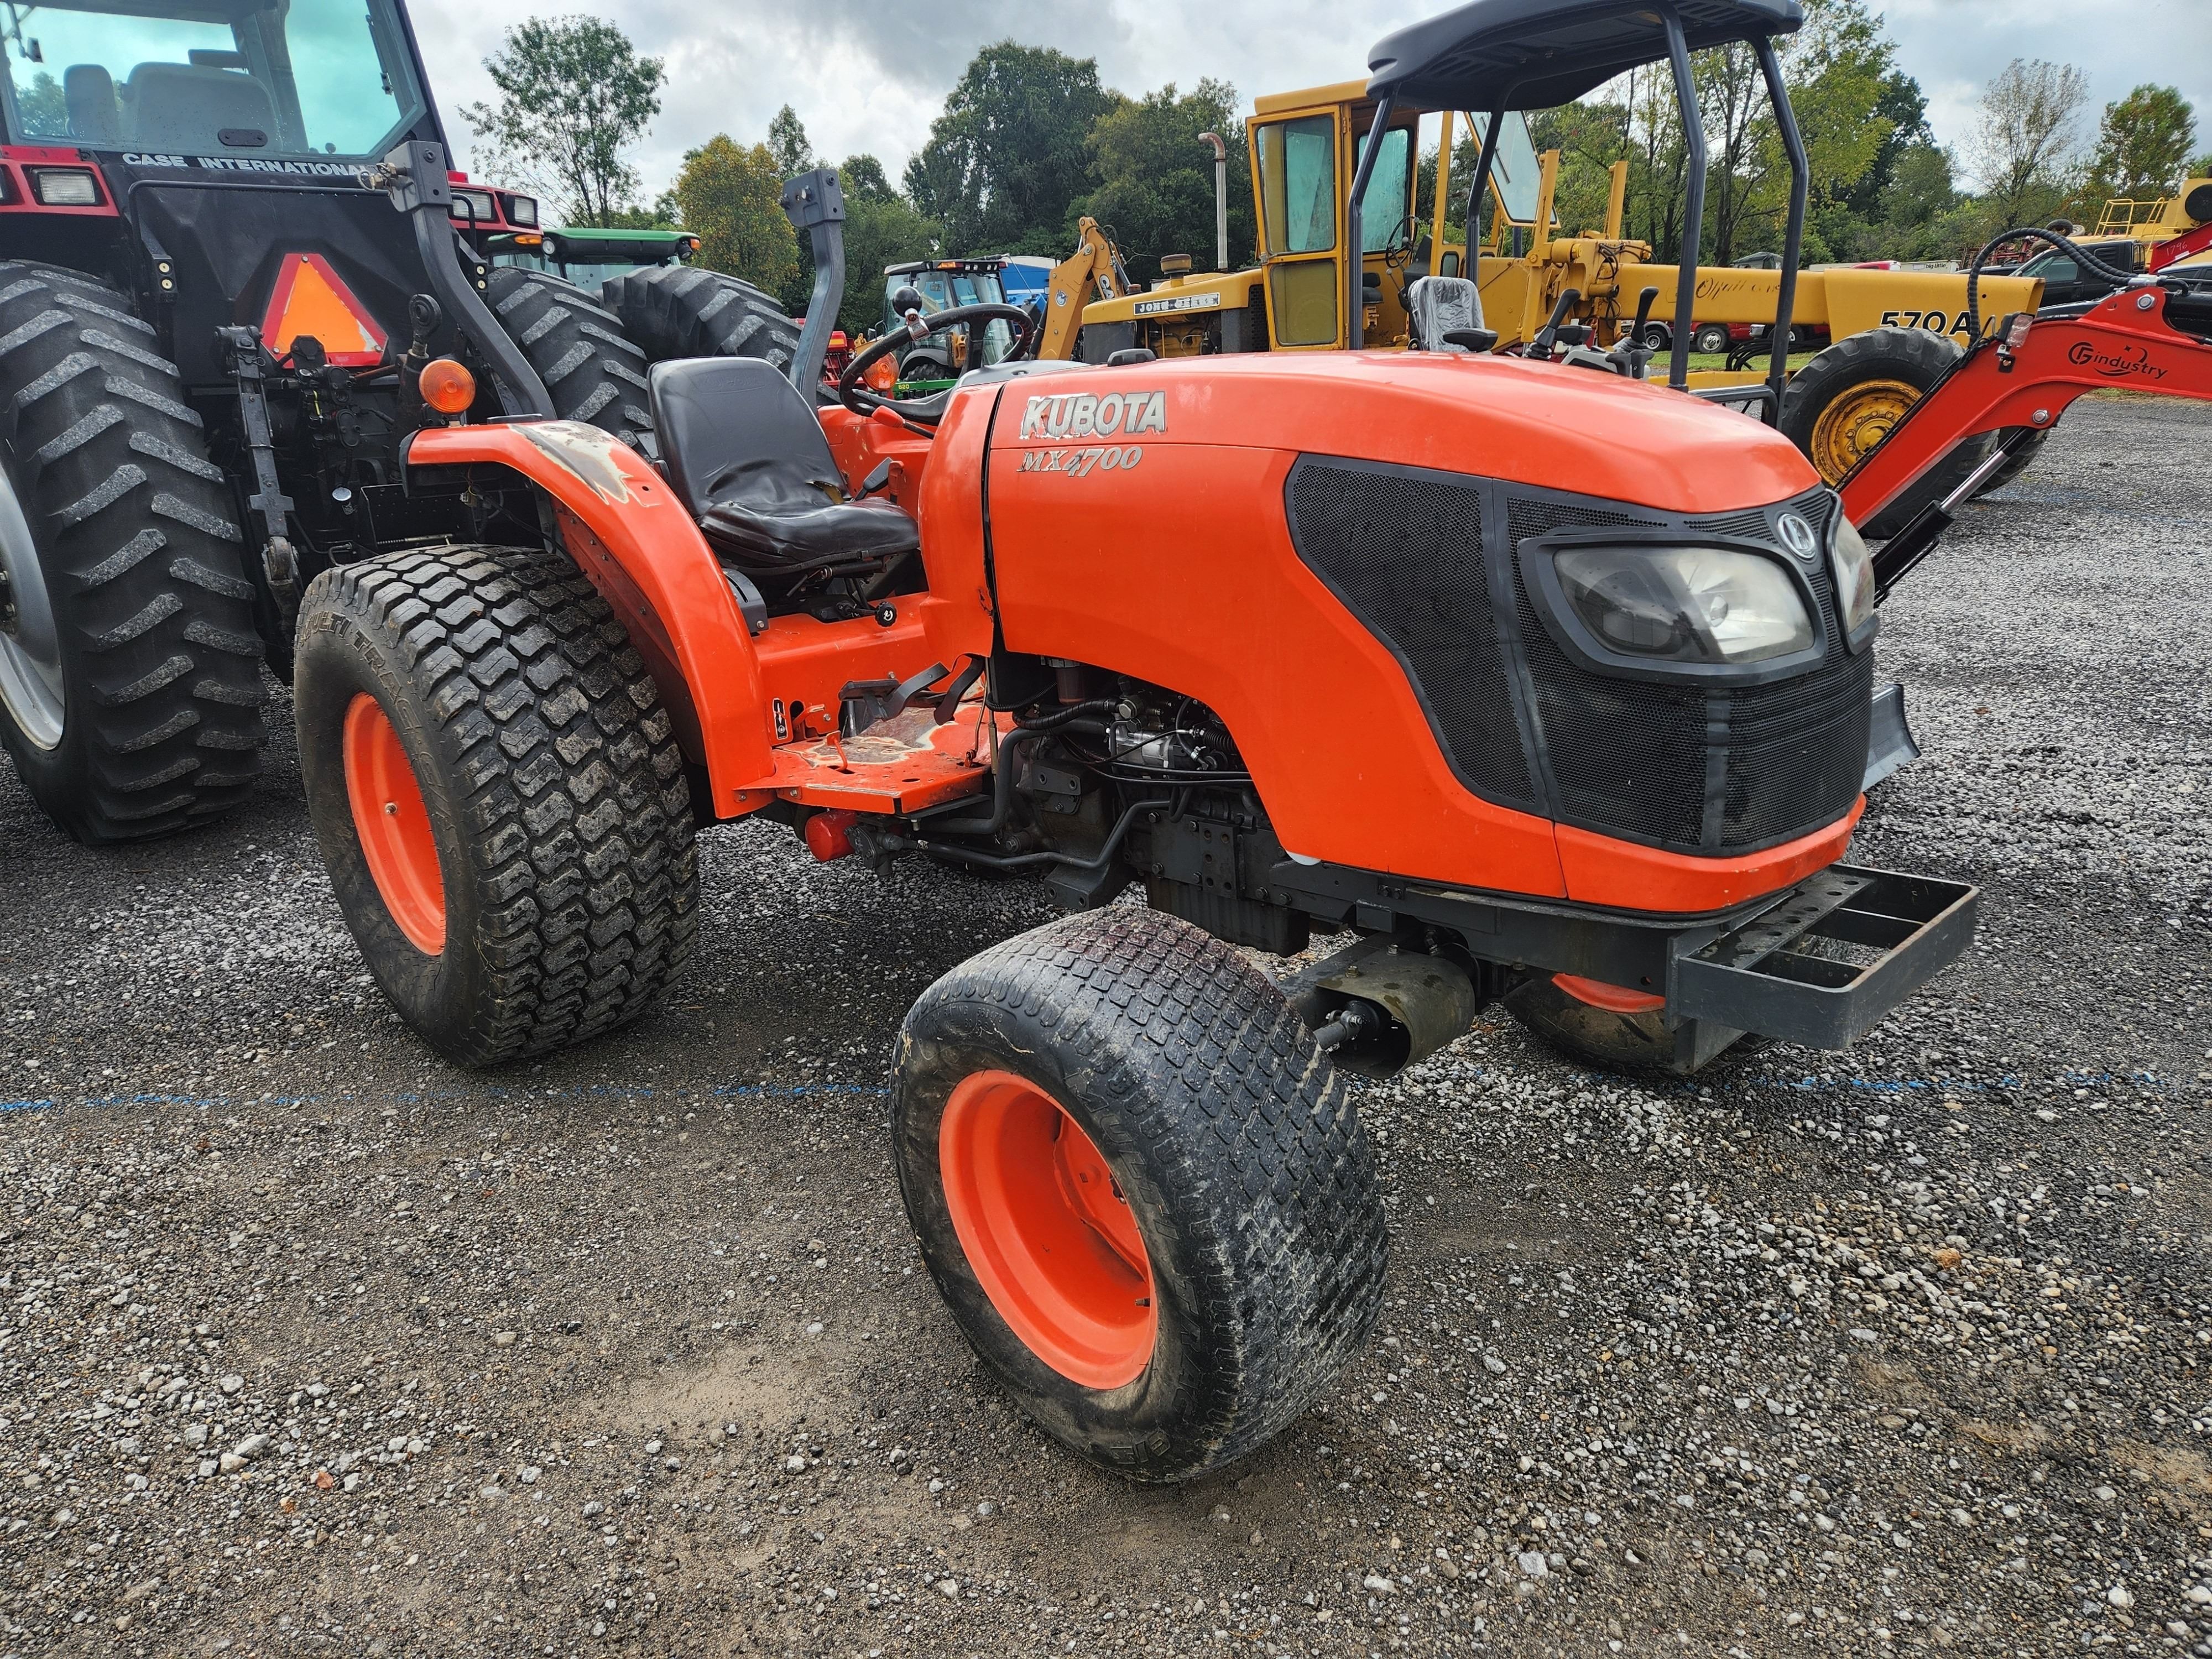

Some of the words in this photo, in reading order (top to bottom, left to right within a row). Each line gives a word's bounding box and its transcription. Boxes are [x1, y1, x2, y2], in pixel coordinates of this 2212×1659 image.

[123, 153, 189, 167] CASE
[2167, 241, 2188, 256] 1796
[1099, 274, 1115, 299] CA
[1021, 391, 1166, 436] KUBOTA
[1016, 446, 1143, 477] MX4700
[351, 629, 422, 729] TRAC
[1063, 1072, 1180, 1240] MULTI
[1172, 1280, 1203, 1420] TRAC
